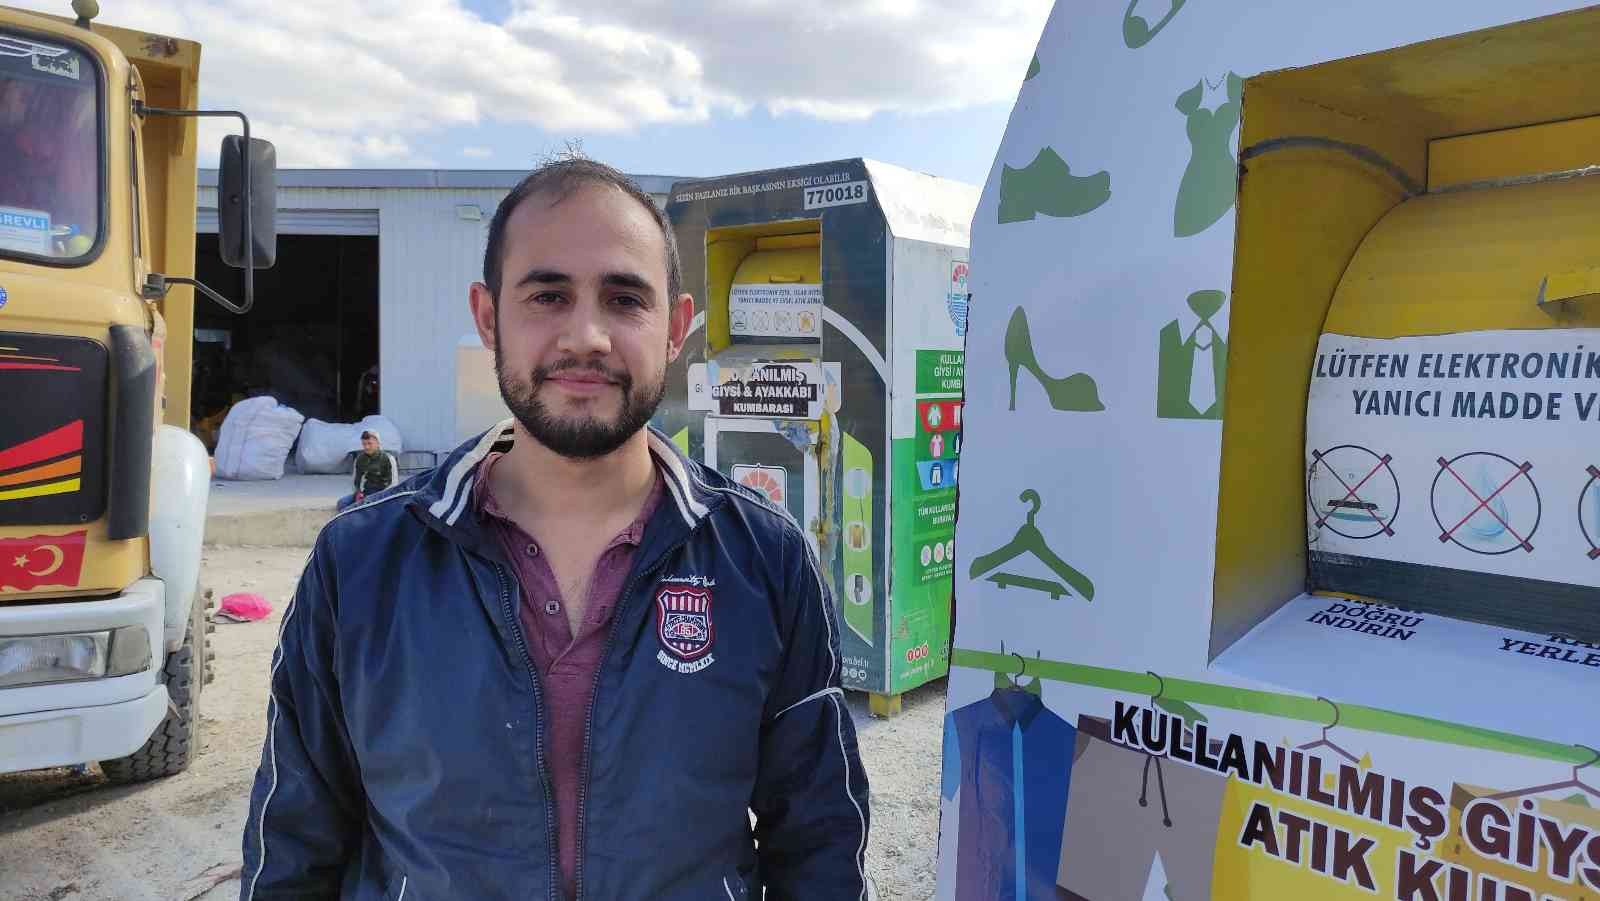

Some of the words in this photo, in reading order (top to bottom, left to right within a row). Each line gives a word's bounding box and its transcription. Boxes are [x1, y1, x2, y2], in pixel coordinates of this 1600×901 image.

[806, 184, 864, 205] 770018
[1315, 348, 1409, 378] LÜTFEN
[1417, 345, 1600, 379] ELEKTRONİK
[712, 384, 741, 398] GİYSİ
[743, 386, 752, 398] &
[754, 386, 812, 399] AYAKKABI
[733, 402, 794, 414] KUMBARASI
[1352, 389, 1441, 417] YANICI
[1451, 391, 1562, 421] MADDE
[1574, 392, 1600, 422] V
[1305, 611, 1417, 641] İNDİRİN
[1326, 602, 1424, 627] DOĞRU
[657, 649, 678, 671] SINCE
[1111, 698, 1447, 851] KULLANILMIŞ
[1239, 802, 1378, 893] ATIK
